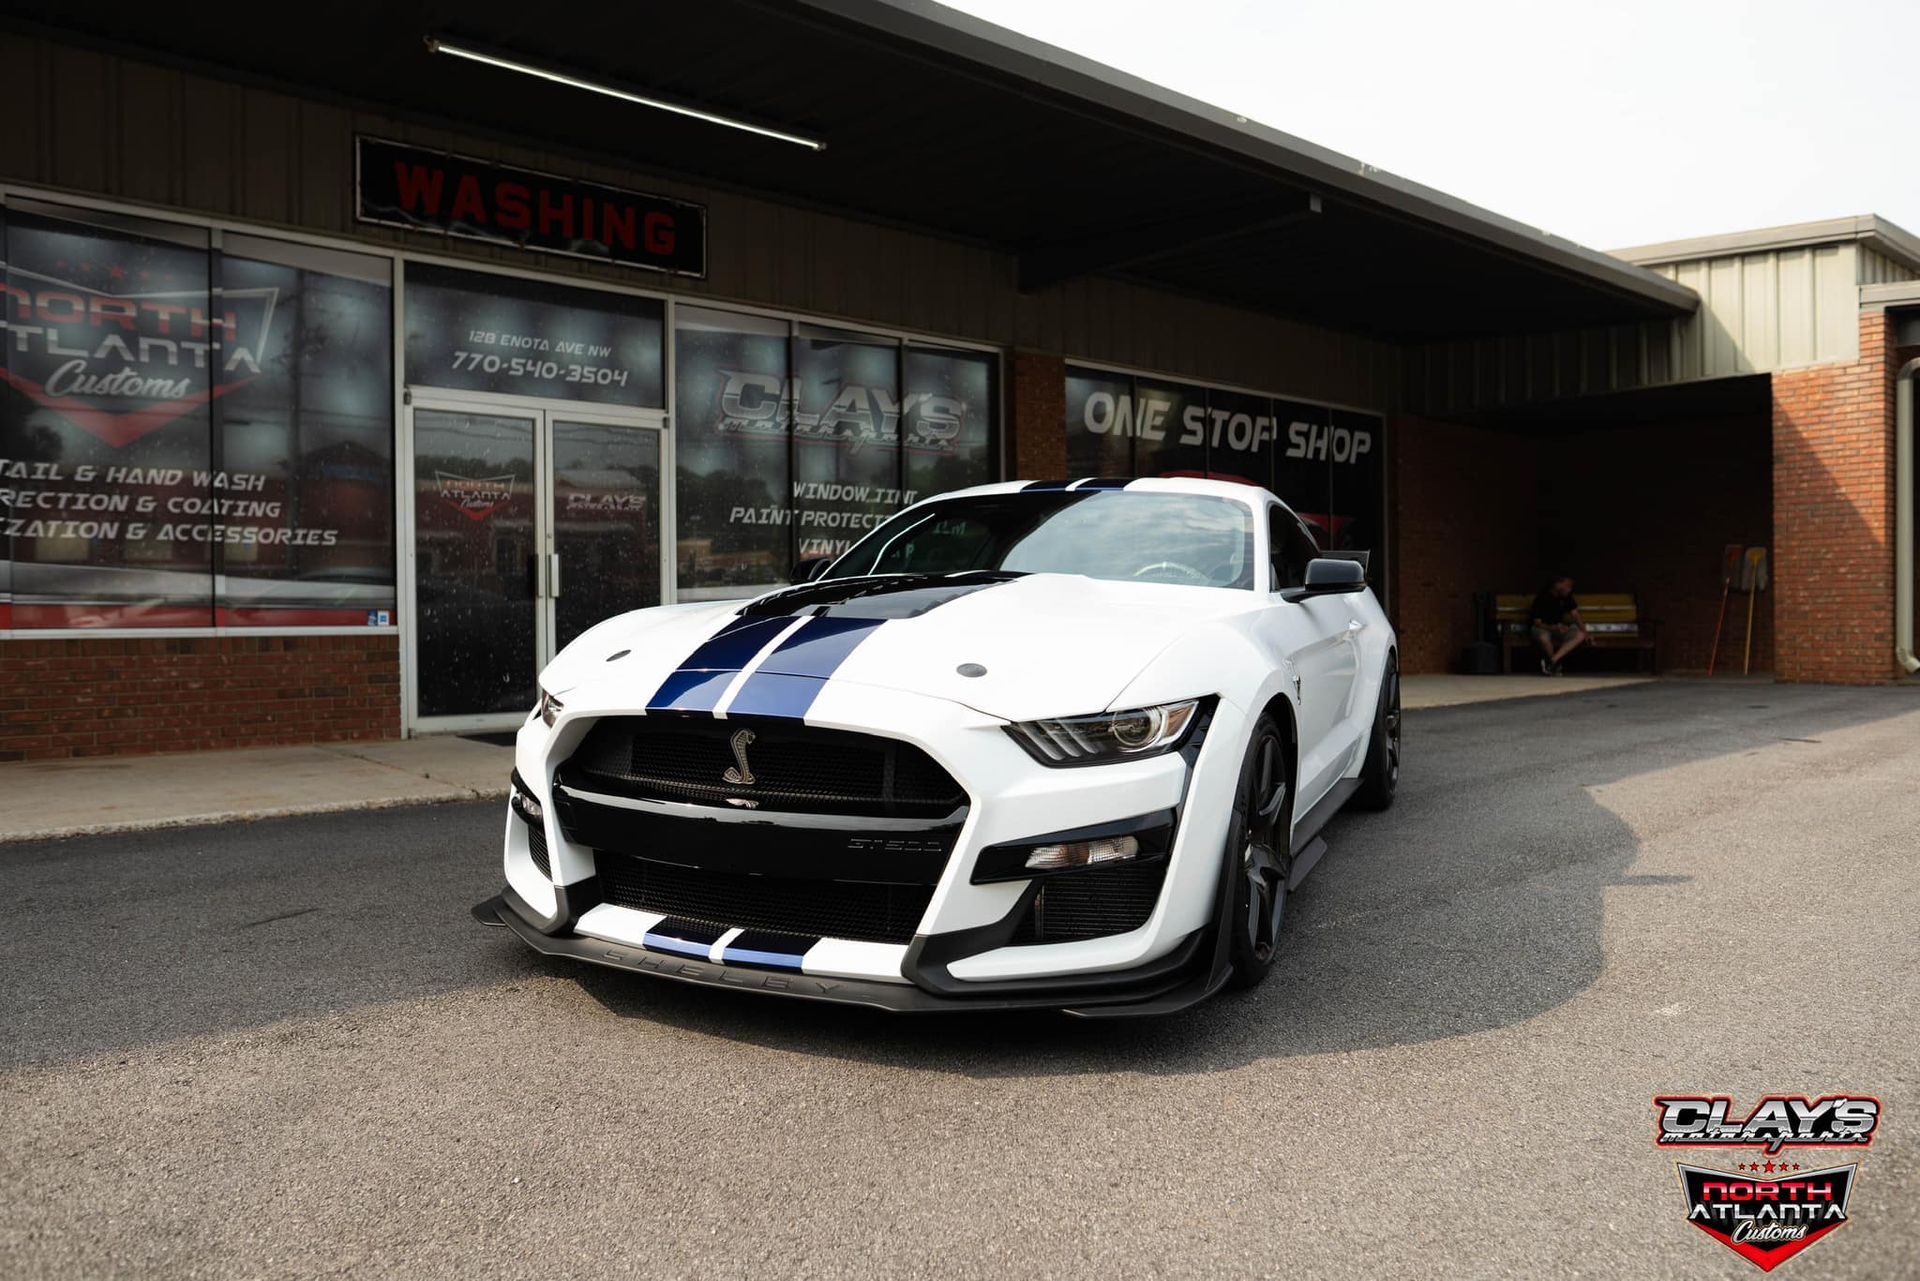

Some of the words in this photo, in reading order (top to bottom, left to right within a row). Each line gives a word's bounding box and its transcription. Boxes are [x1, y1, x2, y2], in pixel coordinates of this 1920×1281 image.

[394, 160, 678, 256] WASHING
[500, 334, 549, 351] ENOTA
[555, 341, 585, 355] AVE
[588, 345, 612, 358] NW
[45, 359, 190, 399] Customs
[452, 351, 628, 387] 770-540-3504
[1084, 391, 1171, 441] ONE
[1179, 405, 1277, 453] STOP
[1285, 422, 1371, 464] SHOP
[74, 465, 97, 482] &
[106, 467, 182, 486] HAND
[193, 470, 265, 491] WASH
[440, 489, 512, 500] ATLANTA
[793, 481, 867, 503] WINDOW
[873, 487, 918, 505] TINT
[135, 496, 157, 512] &
[168, 497, 281, 518] COATING
[729, 506, 799, 526] PAINT
[126, 523, 147, 539] &
[157, 523, 338, 545] ACCESSORIES
[602, 948, 841, 993] SHELBY
